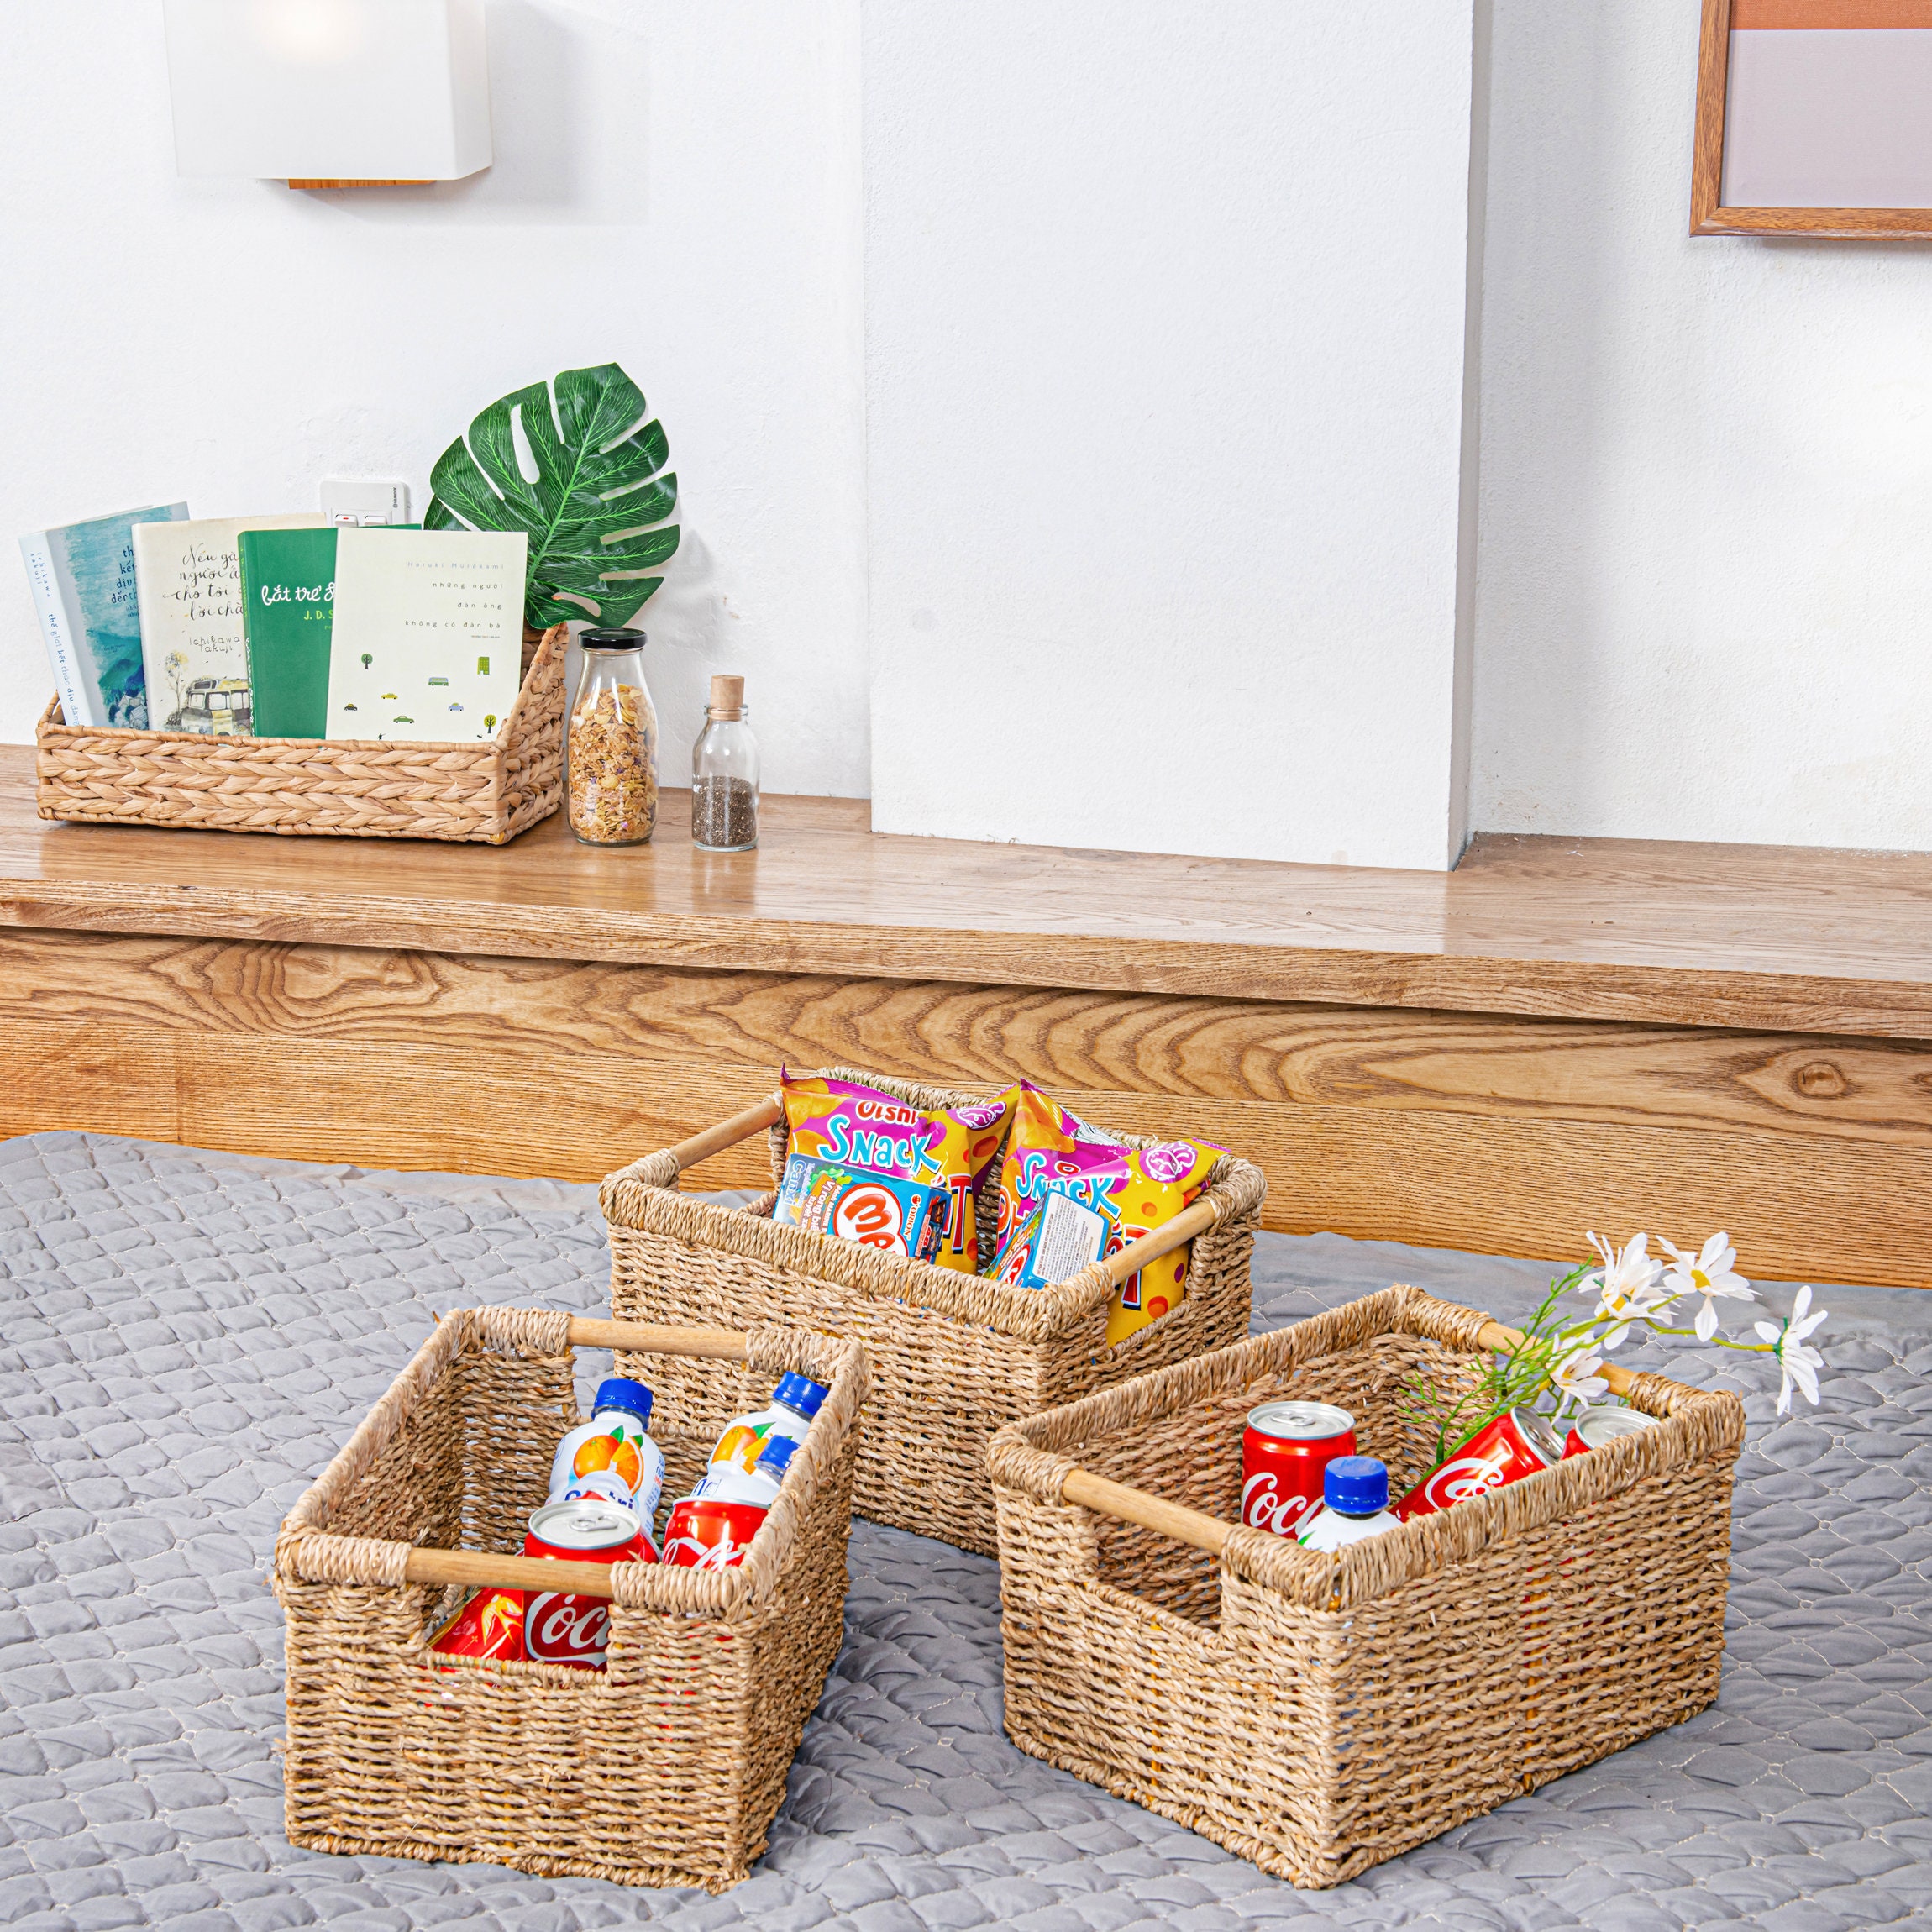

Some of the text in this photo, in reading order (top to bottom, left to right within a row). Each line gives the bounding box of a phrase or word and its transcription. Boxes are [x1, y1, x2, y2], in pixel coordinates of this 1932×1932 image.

[451, 562, 504, 570] Murakami
[433, 580, 466, 590] những
[261, 584, 291, 606] bắt
[294, 585, 323, 602] trẻ
[303, 610, 312, 621] J.
[315, 610, 326, 620] D.
[405, 620, 438, 629] không
[904, 1205, 920, 1238] ORION
